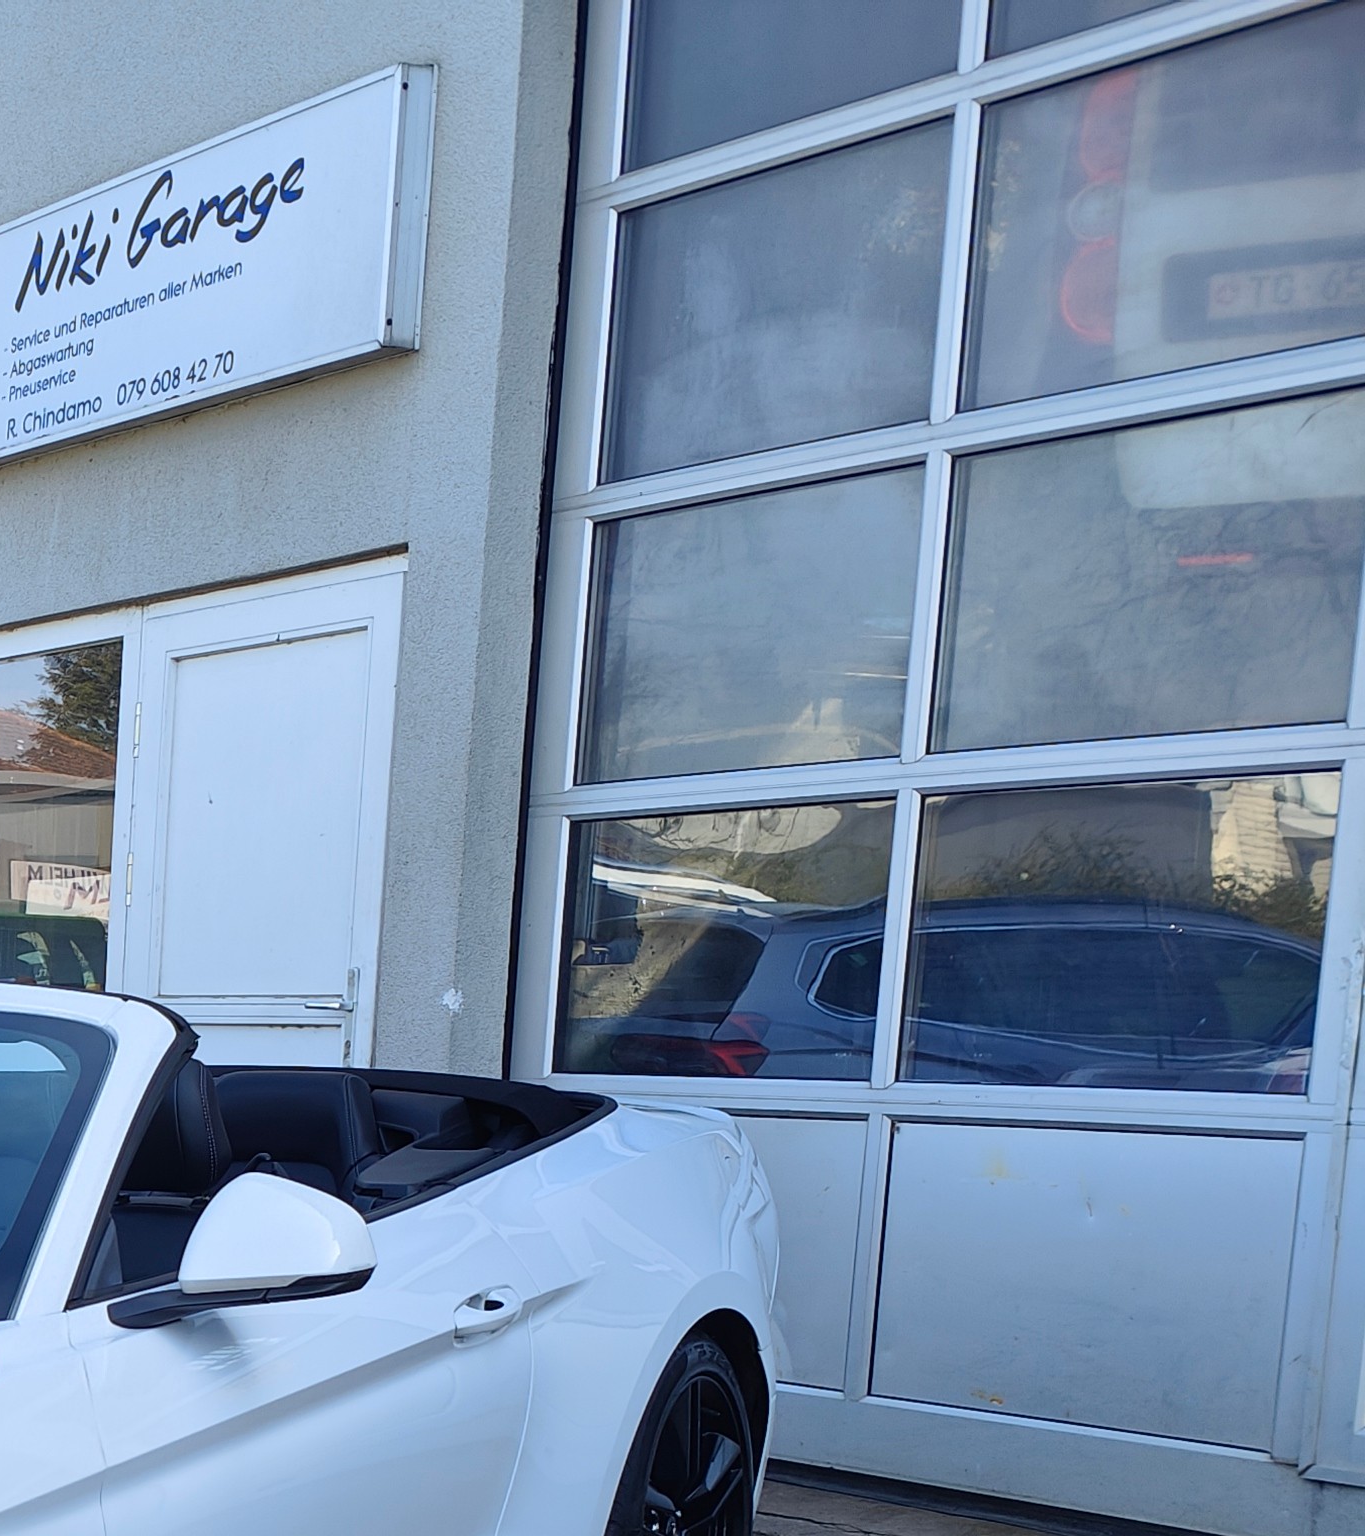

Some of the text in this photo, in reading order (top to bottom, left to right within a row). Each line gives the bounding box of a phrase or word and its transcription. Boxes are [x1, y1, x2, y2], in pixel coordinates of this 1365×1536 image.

[15, 157, 305, 313] Niki Garage
[10, 262, 243, 354] Service und Reparaturen aller Marken
[9, 369, 76, 403] Pneuservice
[10, 338, 95, 379] Abgaswartung
[22, 396, 103, 434] Chindamo
[116, 377, 147, 406] 079
[150, 366, 181, 396] 608
[185, 358, 208, 385] 42
[212, 350, 234, 378] 70
